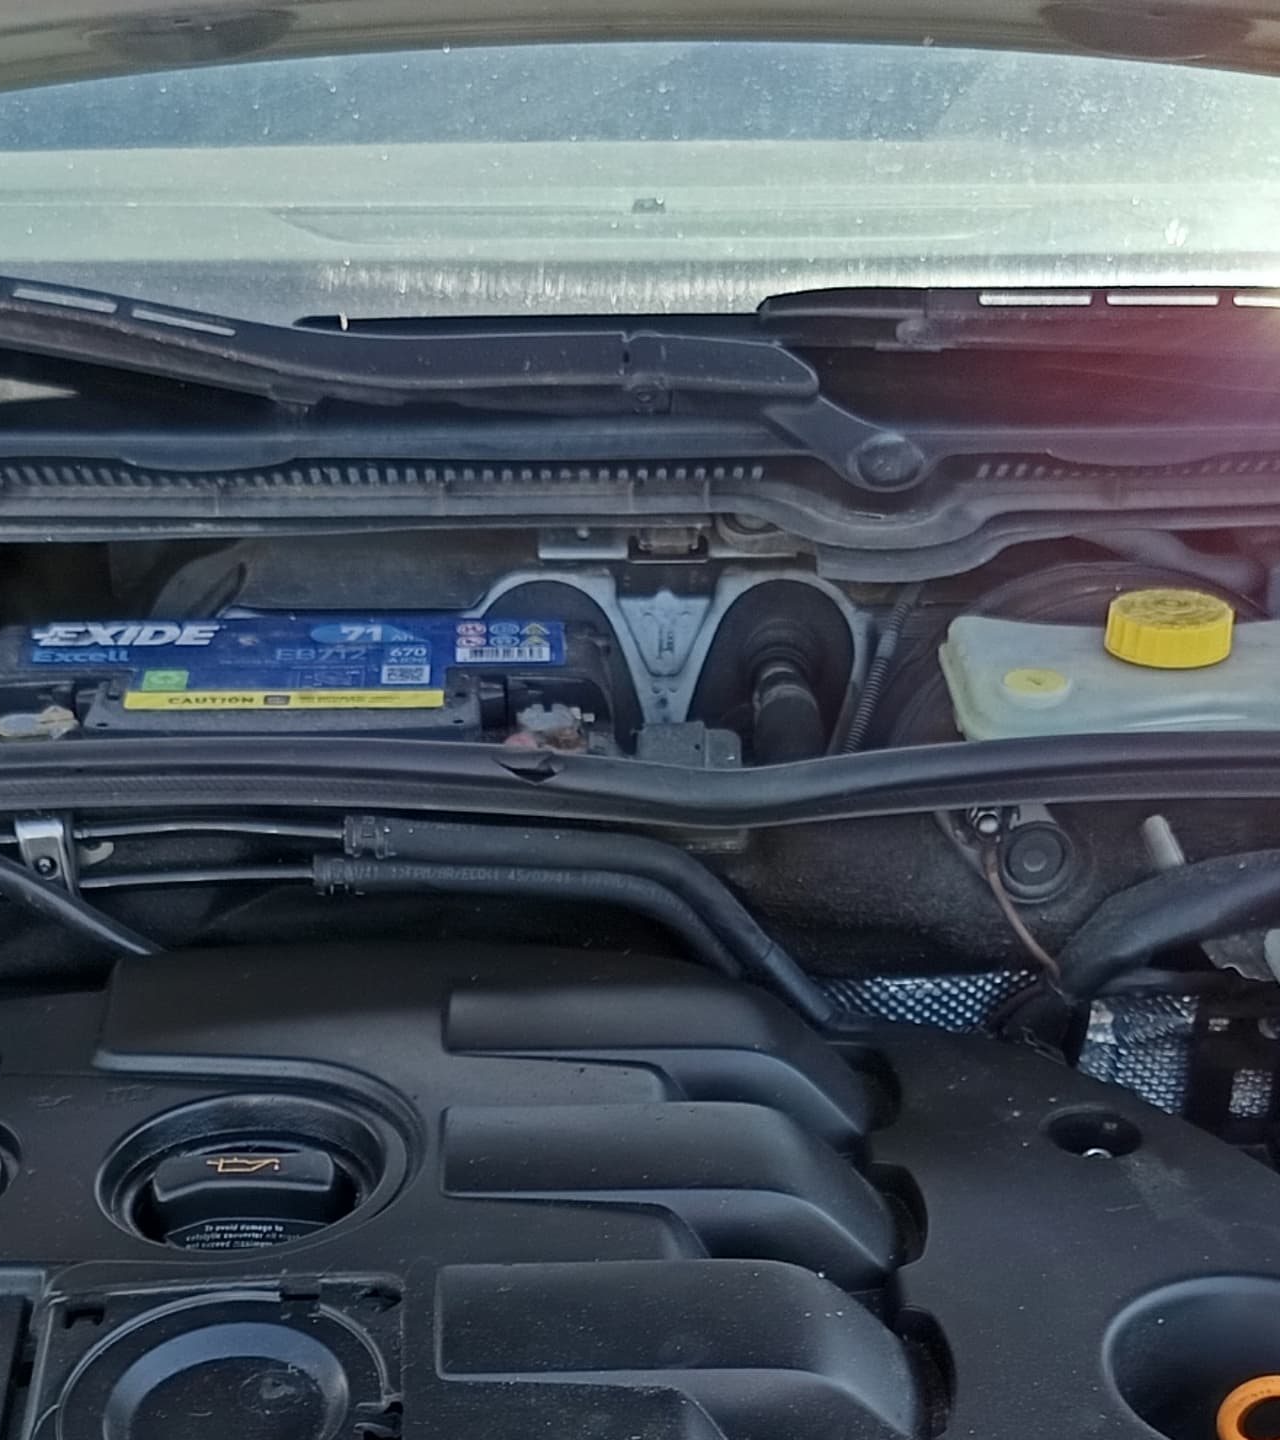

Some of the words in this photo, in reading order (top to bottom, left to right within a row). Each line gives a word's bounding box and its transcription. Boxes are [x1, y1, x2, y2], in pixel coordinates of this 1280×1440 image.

[32, 622, 220, 646] EXIDE
[340, 625, 382, 642] 71
[32, 649, 129, 663] Excell
[275, 648, 368, 662] EB712
[389, 646, 427, 657] 670
[167, 695, 255, 705] CAUTION
